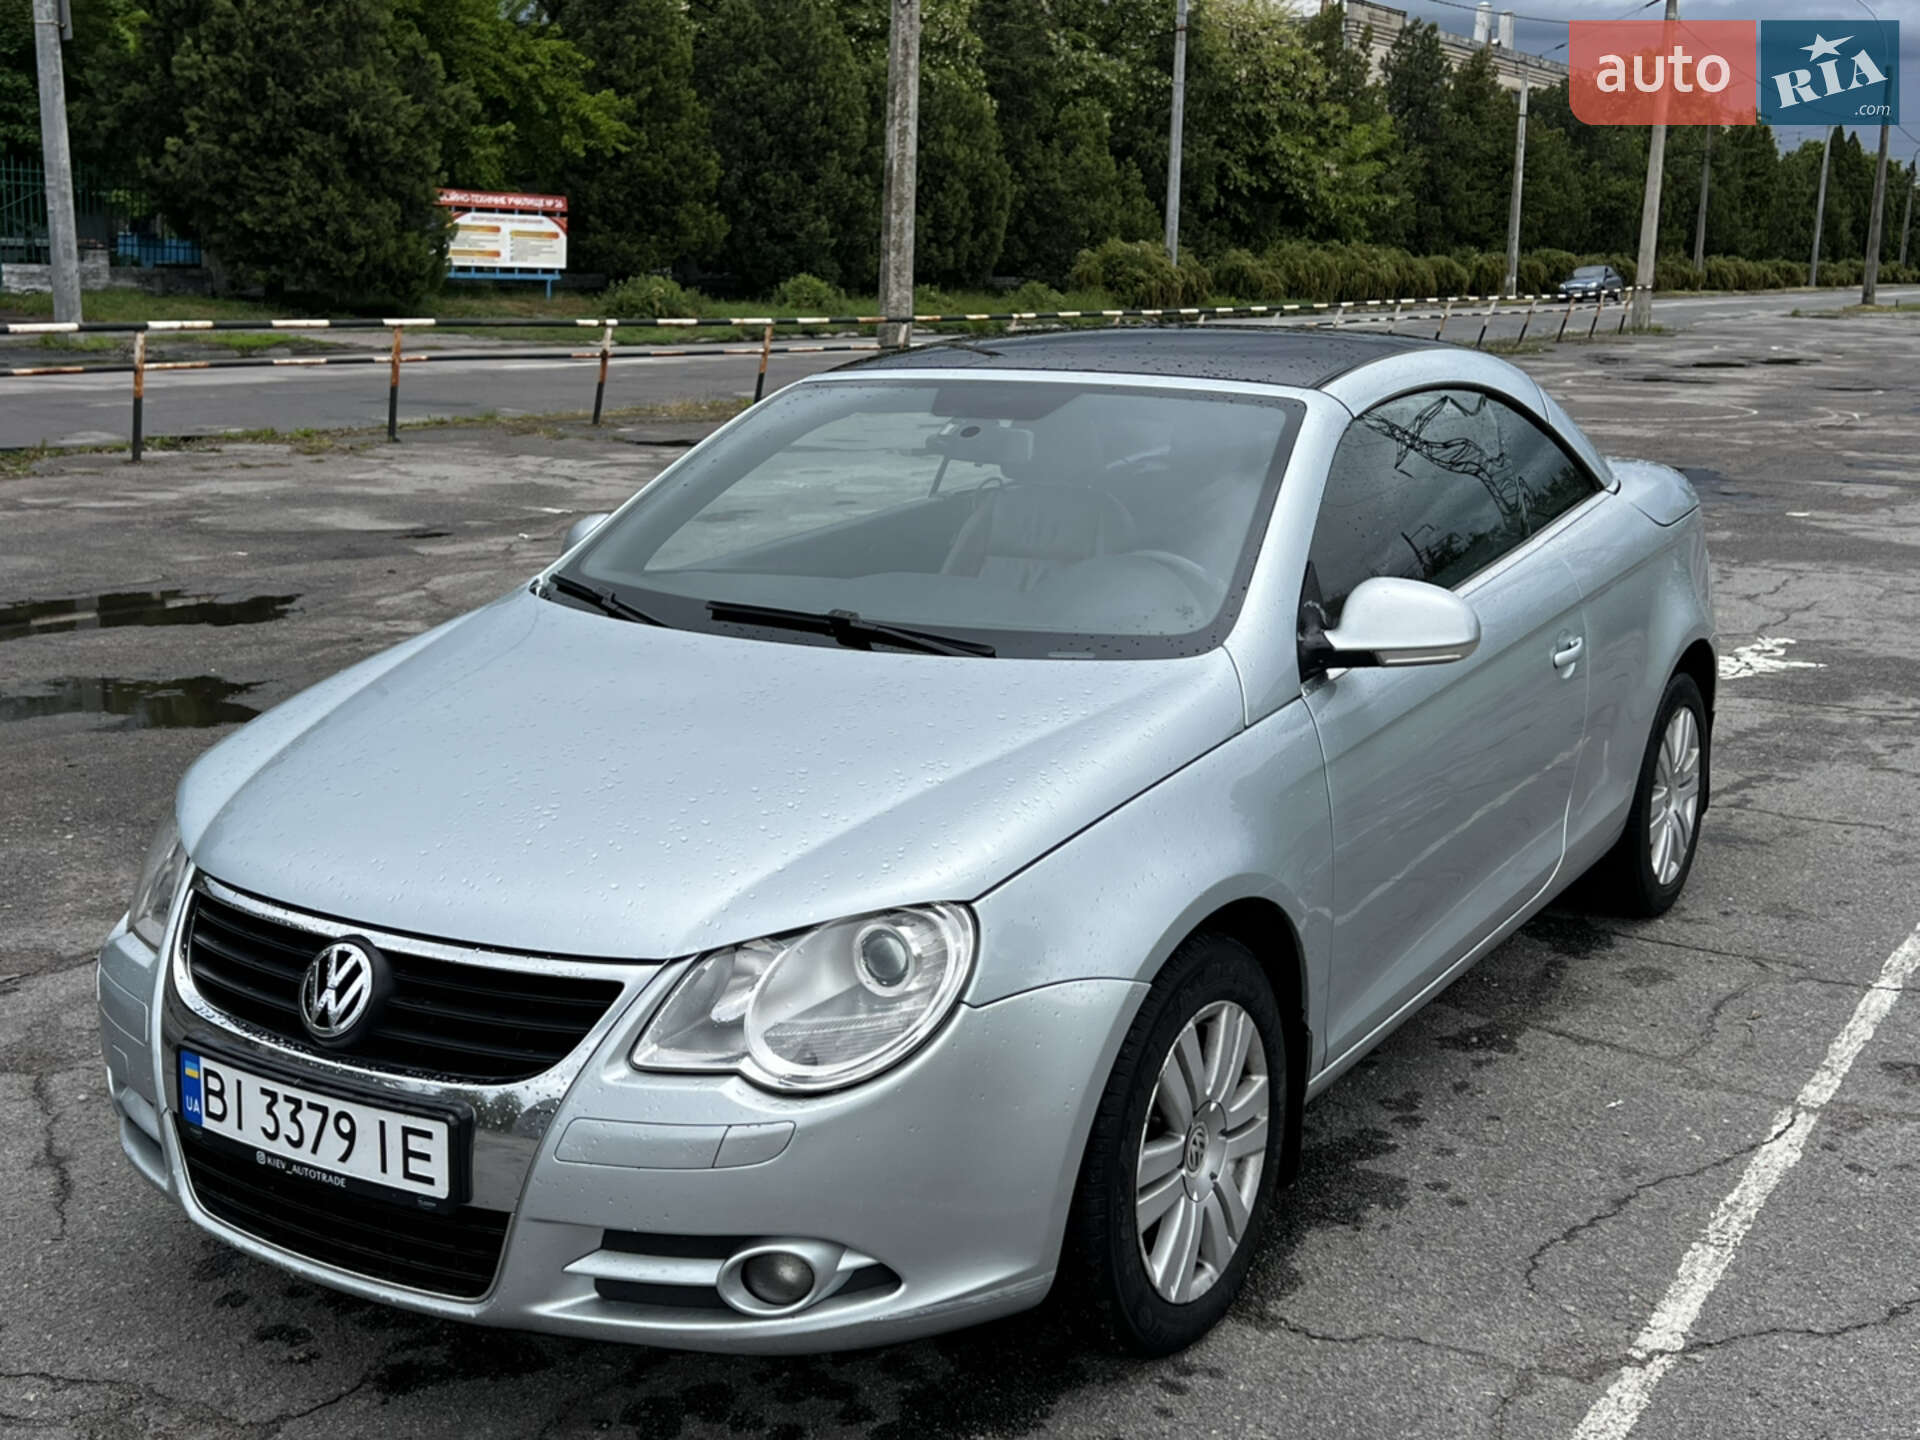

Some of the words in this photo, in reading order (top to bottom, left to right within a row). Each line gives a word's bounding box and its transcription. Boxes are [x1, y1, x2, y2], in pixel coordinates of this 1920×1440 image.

[185, 1095, 201, 1115] UA
[203, 1067, 243, 1131] BI
[259, 1086, 357, 1164] 3379
[378, 1119, 436, 1187] IE
